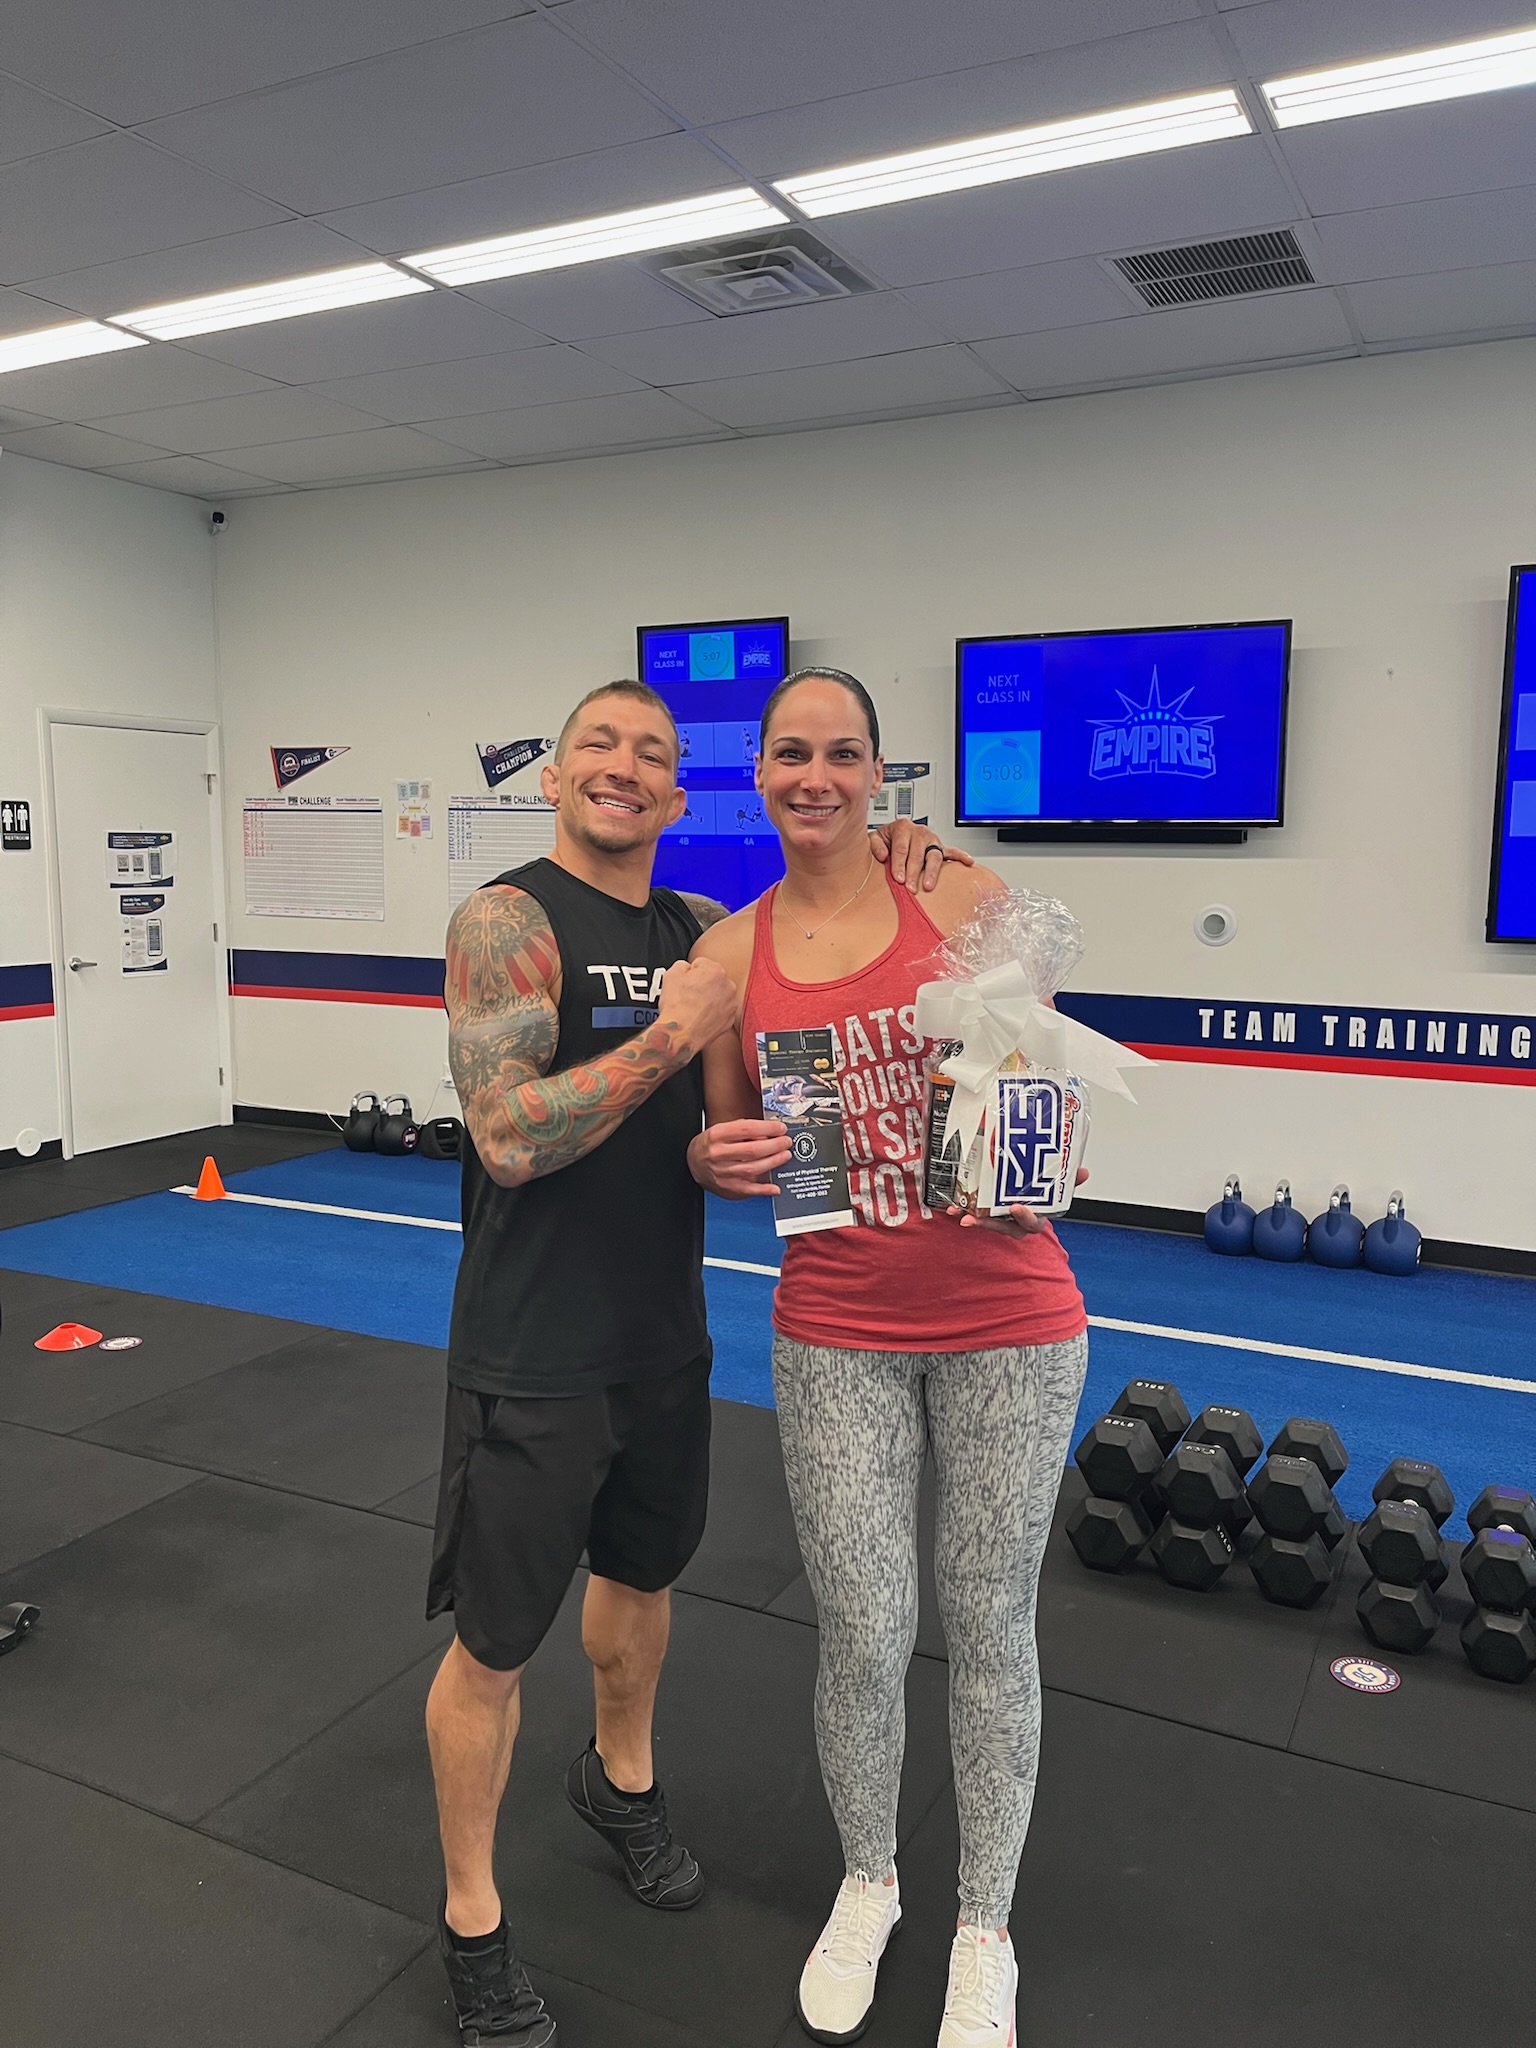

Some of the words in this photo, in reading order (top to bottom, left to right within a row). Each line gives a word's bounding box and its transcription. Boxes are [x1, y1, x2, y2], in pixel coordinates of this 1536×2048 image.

[658, 650, 677, 659] NEXT
[703, 651, 721, 661] 5:07
[743, 653, 771, 666] EMPIRE
[654, 660, 676, 669] CLASS
[676, 659, 684, 668] IN
[988, 674, 1019, 688] NEXT
[976, 691, 1014, 704] CLASS
[1018, 690, 1030, 703] IN
[1094, 725, 1212, 772] EMPIRE
[495, 749, 533, 775] CHAMPION
[982, 763, 1023, 781] 5:08
[299, 796, 332, 806] CHALLENGE
[679, 837, 689, 845] 4B
[744, 837, 755, 845] 4A
[1199, 1008, 1296, 1043] TEAM
[1322, 1015, 1531, 1059] TRAINING
[777, 1171, 796, 1179] Doctors
